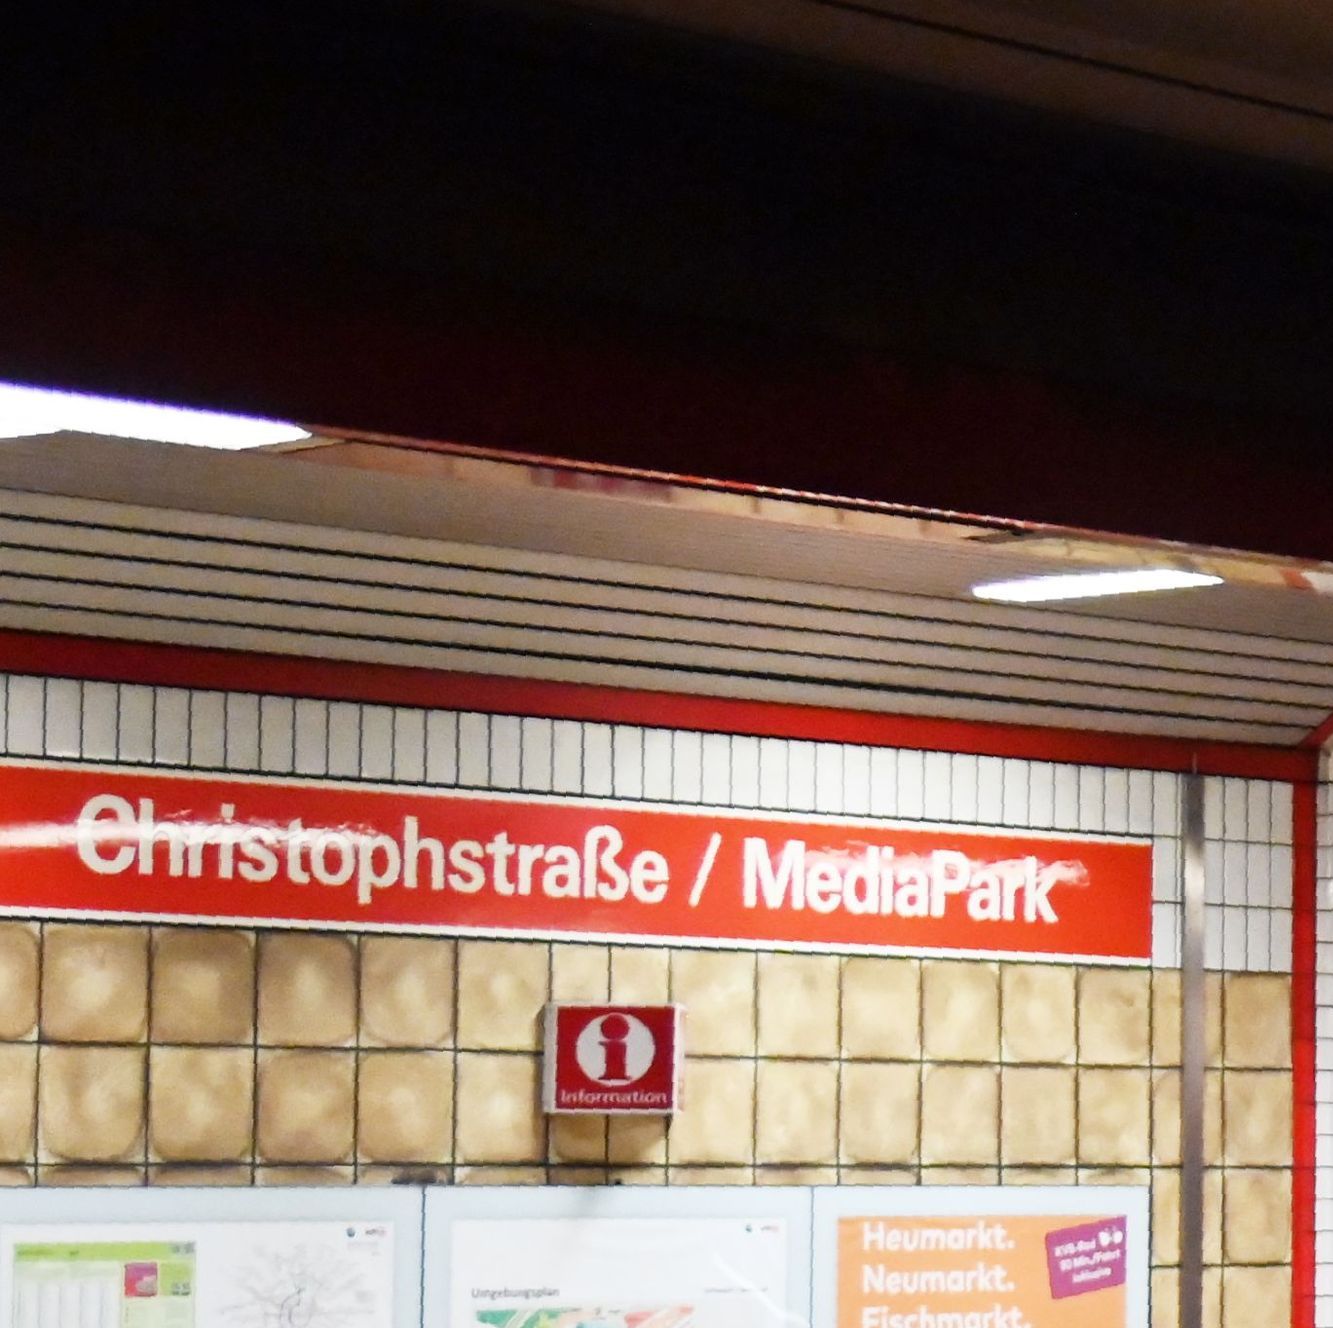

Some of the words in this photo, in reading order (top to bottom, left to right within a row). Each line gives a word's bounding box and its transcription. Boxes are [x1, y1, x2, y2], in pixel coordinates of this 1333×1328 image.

[76, 794, 669, 905] Christophstraße
[690, 832, 722, 906] /
[743, 836, 1059, 923] MediaPark
[560, 1088, 668, 1105] Information
[862, 1220, 1016, 1252] Heumarkt.
[862, 1261, 1017, 1294] Neumarkt.
